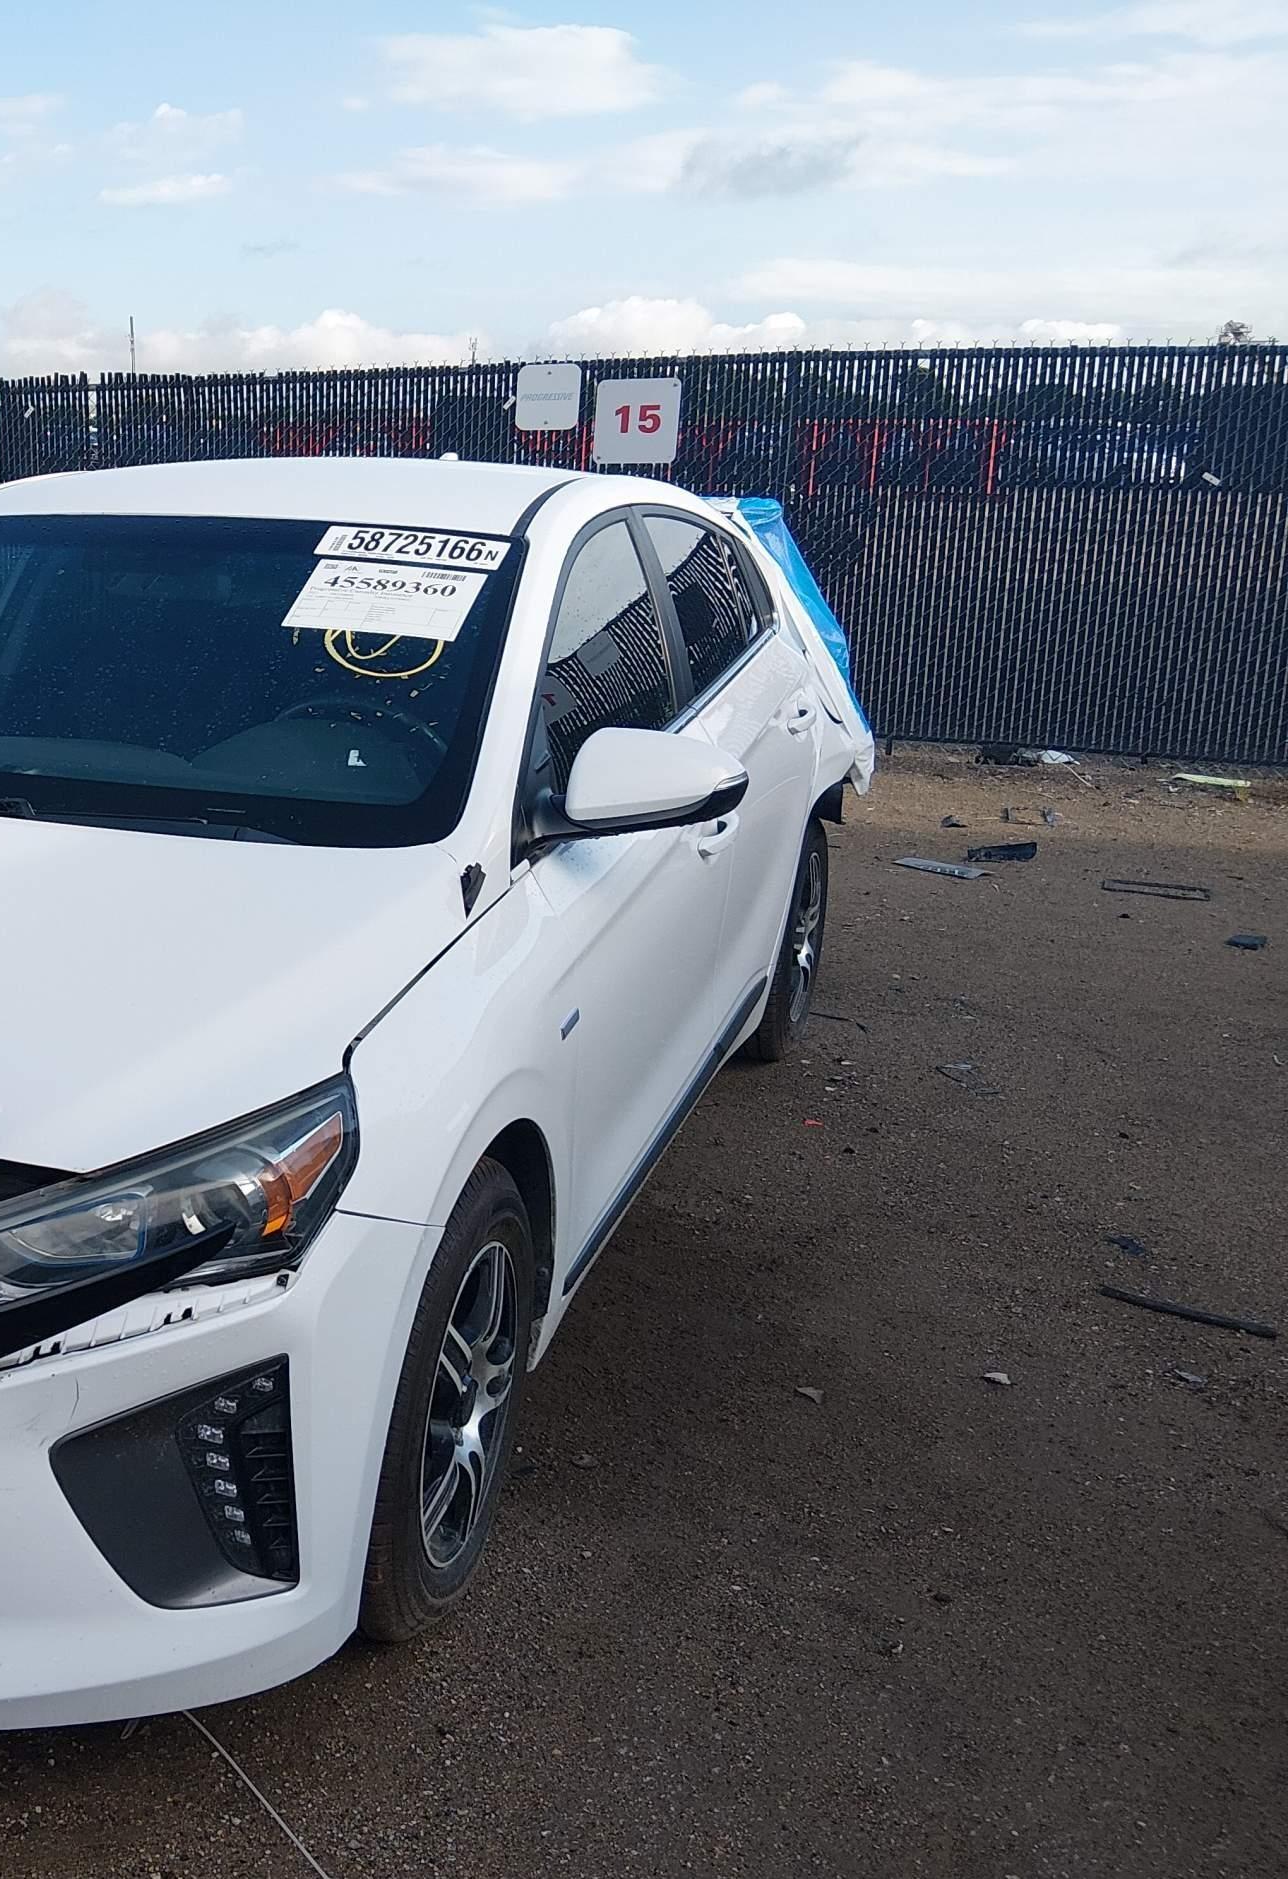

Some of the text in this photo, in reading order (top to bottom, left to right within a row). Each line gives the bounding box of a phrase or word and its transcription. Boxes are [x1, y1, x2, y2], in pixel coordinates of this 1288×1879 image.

[614, 404, 661, 434] 15
[347, 529, 487, 562] 58725166
[484, 549, 499, 562] N
[324, 575, 457, 598] 45589360
